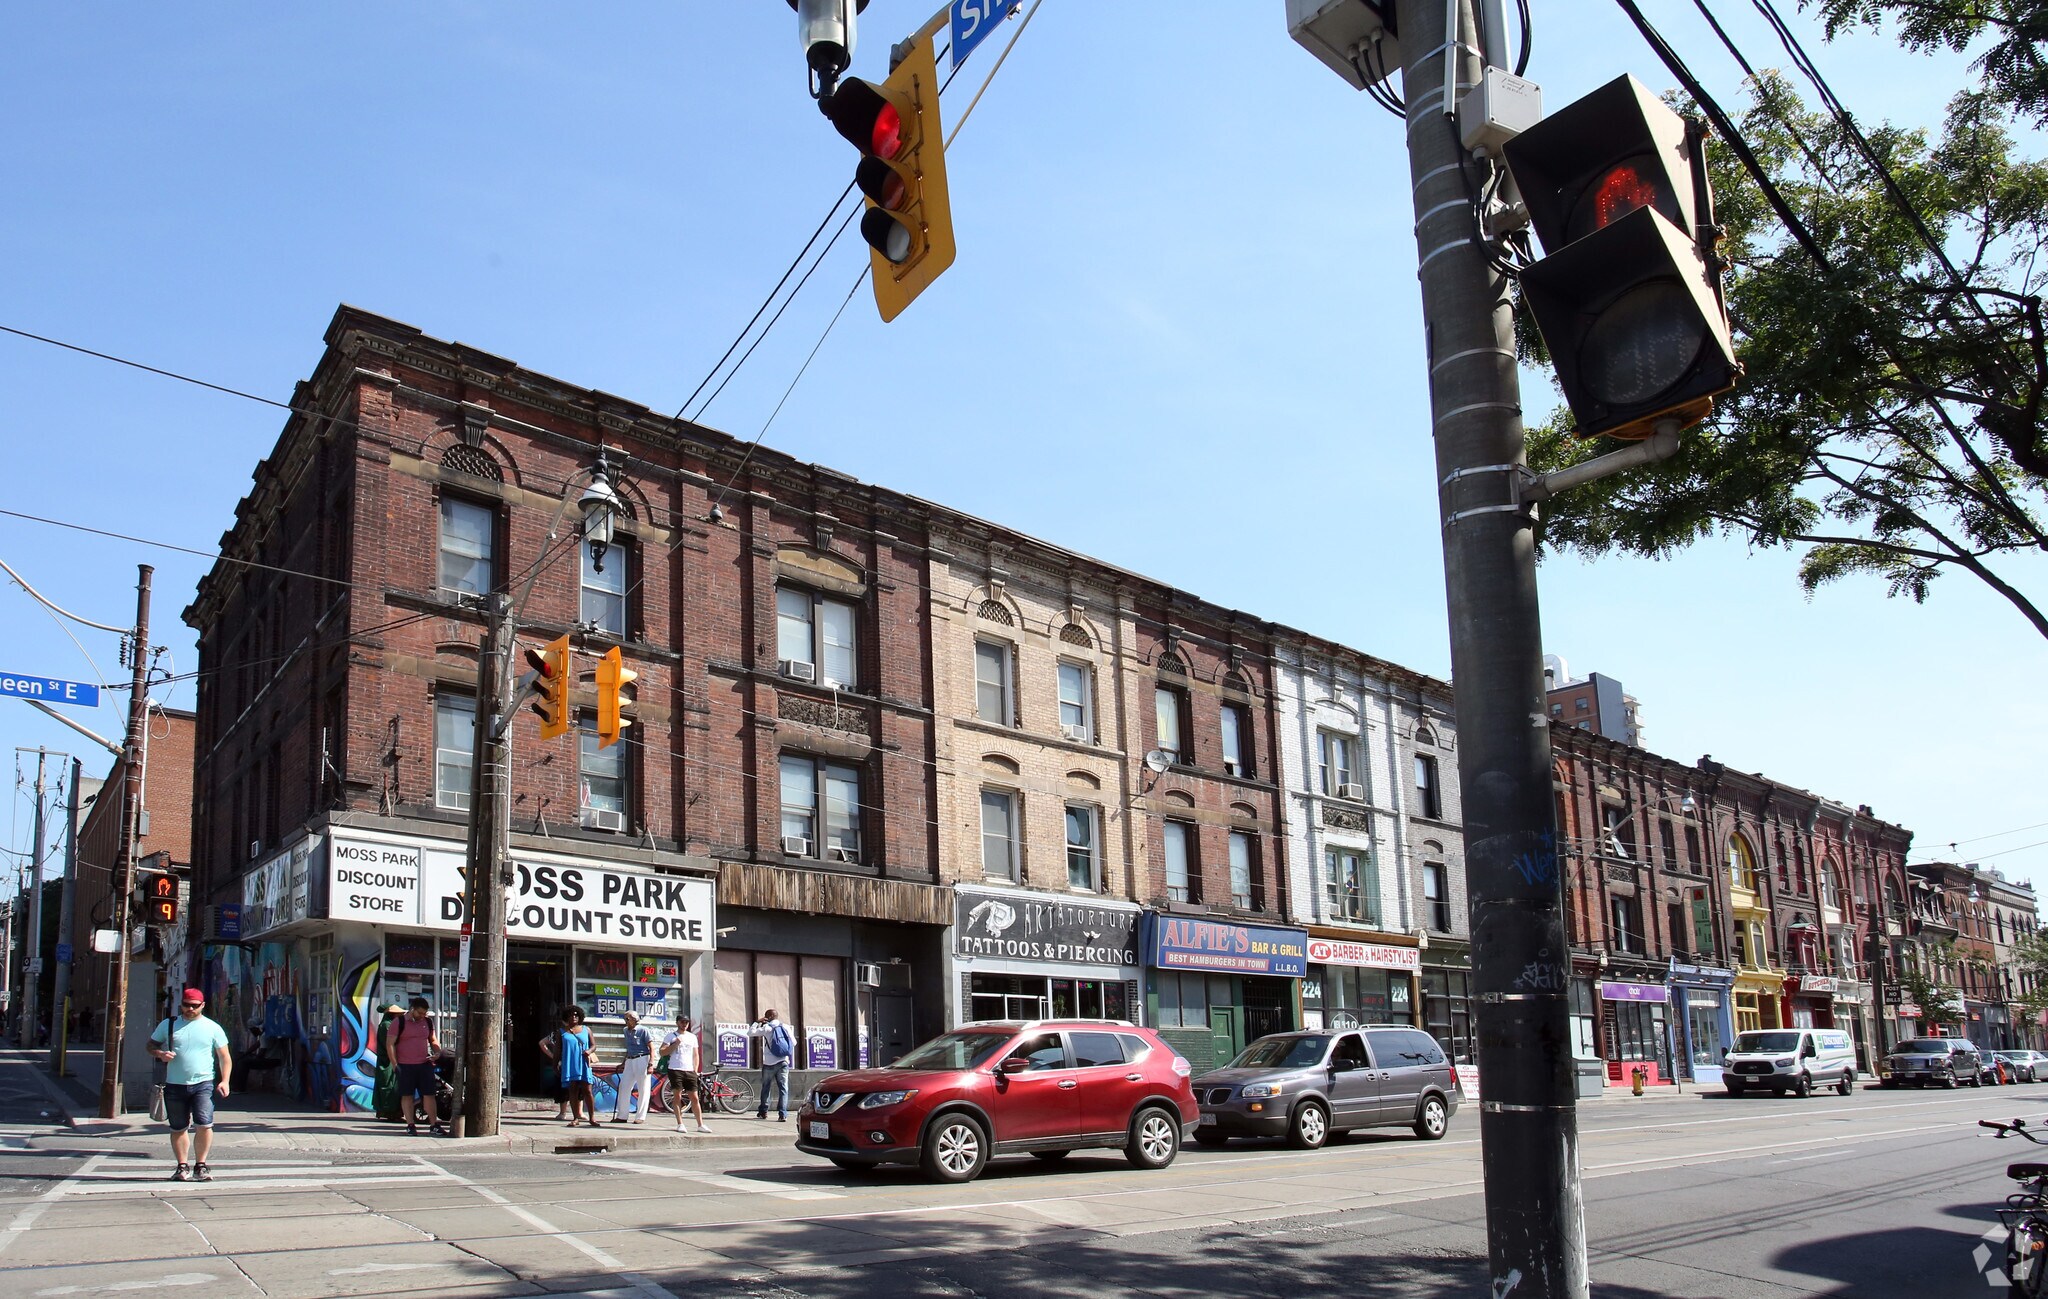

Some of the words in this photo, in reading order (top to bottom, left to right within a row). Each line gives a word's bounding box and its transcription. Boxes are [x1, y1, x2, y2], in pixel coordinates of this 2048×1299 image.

[0, 677, 43, 695] een
[48, 681, 60, 690] St
[65, 683, 77, 699] E
[336, 846, 378, 862] MOSS
[382, 852, 419, 867] PARK
[337, 869, 417, 890] DISCOUNT
[602, 873, 686, 912] PARK
[161, 903, 171, 920] 9
[349, 894, 404, 912] STORE
[619, 914, 703, 942] STORE
[1162, 920, 1250, 953] ALFIE'S
[961, 936, 1040, 957] TATTOOS
[1043, 943, 1054, 958] &
[1251, 941, 1269, 954] BAR
[1271, 943, 1277, 955] &
[1280, 944, 1303, 957] GRILL
[1313, 945, 1328, 957] AT
[1333, 944, 1364, 961] BARBER
[1370, 947, 1417, 965] HAIRSTYLIST
[595, 959, 627, 977] ATM
[1168, 953, 1187, 963] BEST
[1189, 954, 1236, 967] HAMBURGERS
[1238, 959, 1246, 967] IN
[1248, 960, 1266, 968] TOWN
[1275, 963, 1299, 973] L.L.B.O.
[644, 966, 655, 975] 60
[1301, 981, 1321, 998] 224
[1391, 986, 1408, 1002] 224
[724, 1040, 744, 1051] HOME
[813, 1043, 832, 1053] HOME
